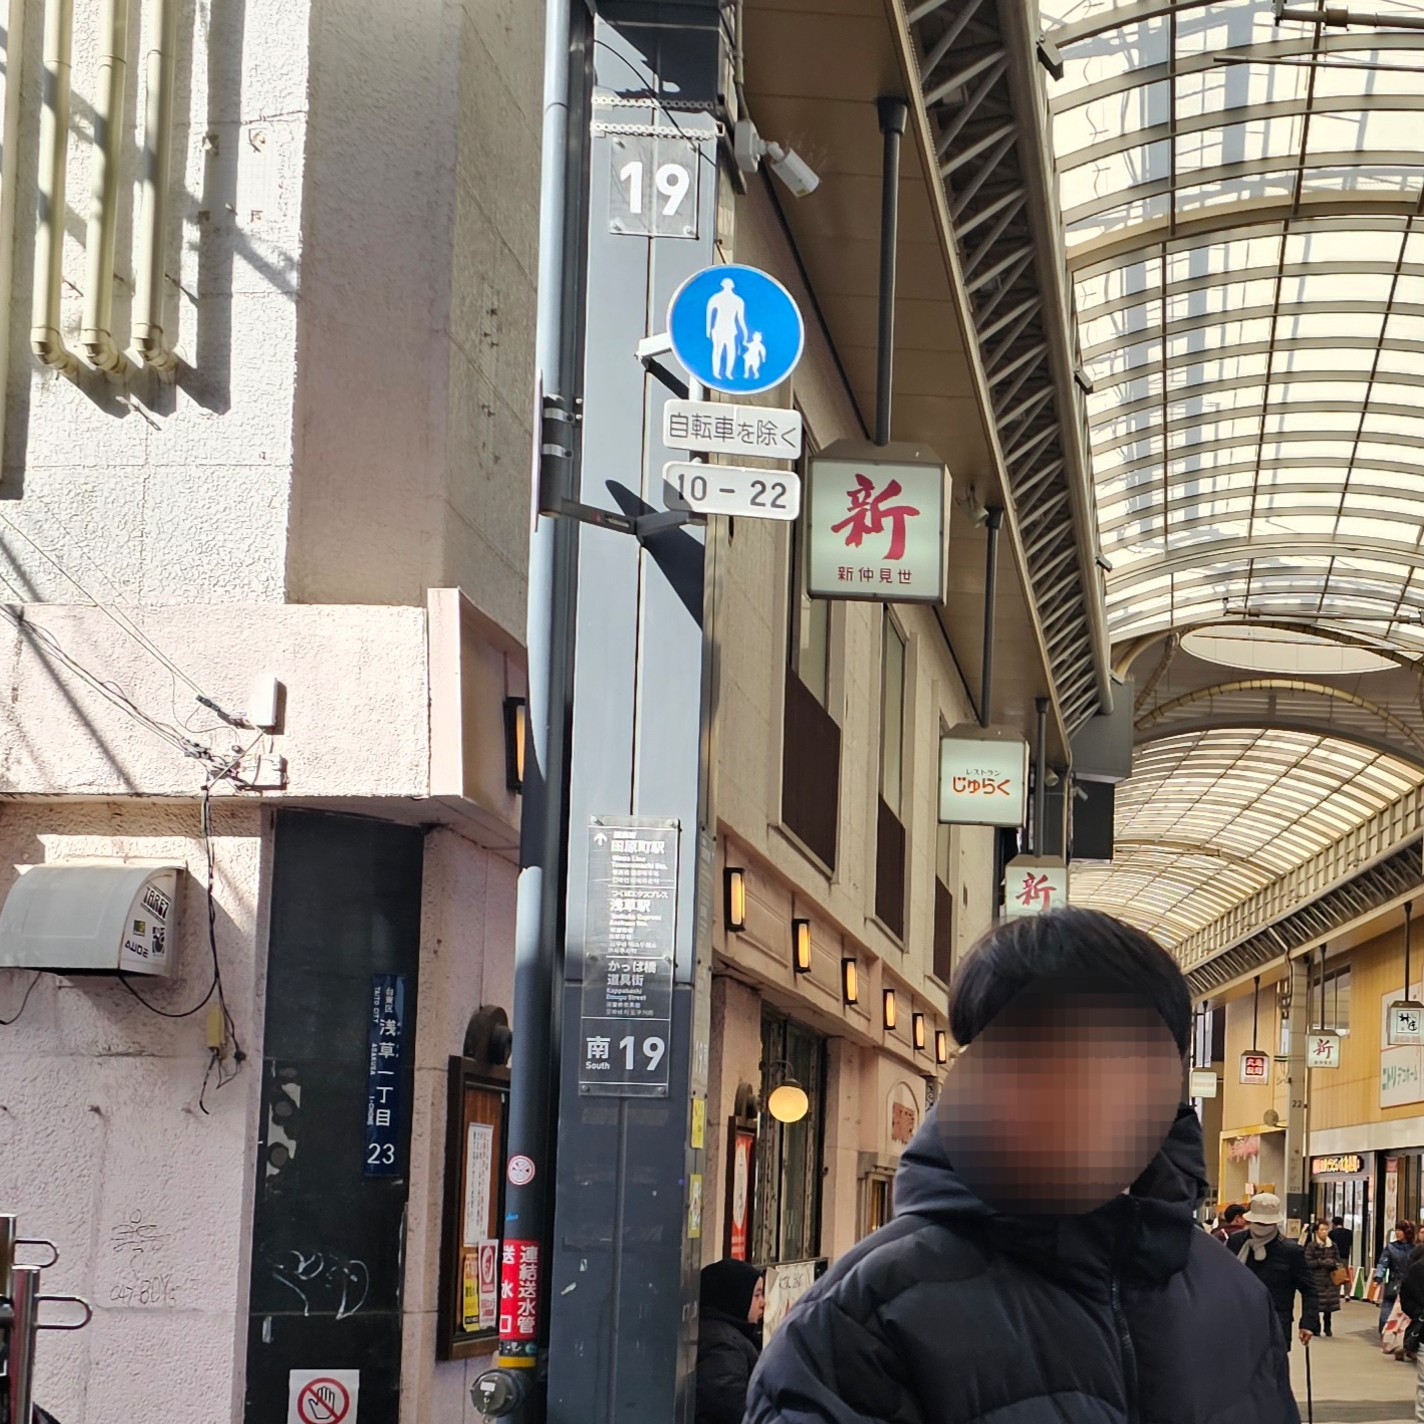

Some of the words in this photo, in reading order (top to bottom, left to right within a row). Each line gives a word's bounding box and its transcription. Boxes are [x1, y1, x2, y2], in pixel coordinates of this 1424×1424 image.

[619, 161, 691, 216] 19
[669, 411, 797, 449] 自転車を除く
[831, 473, 920, 561] 新
[837, 565, 913, 585] 新仲見世
[952, 776, 1011, 796] じゅらく
[965, 768, 1001, 777] レストラン
[1016, 872, 1056, 911] 新
[607, 974, 644, 986] 道具街
[586, 1036, 611, 1059] 南
[619, 1036, 665, 1071] 19
[586, 1061, 610, 1070] South
[1312, 1038, 1334, 1059] 新
[376, 1019, 396, 1126] 浅草一丁目
[367, 1143, 395, 1165] 23
[499, 1245, 516, 1333] 送水口
[517, 1245, 539, 1334] 連結送水管
